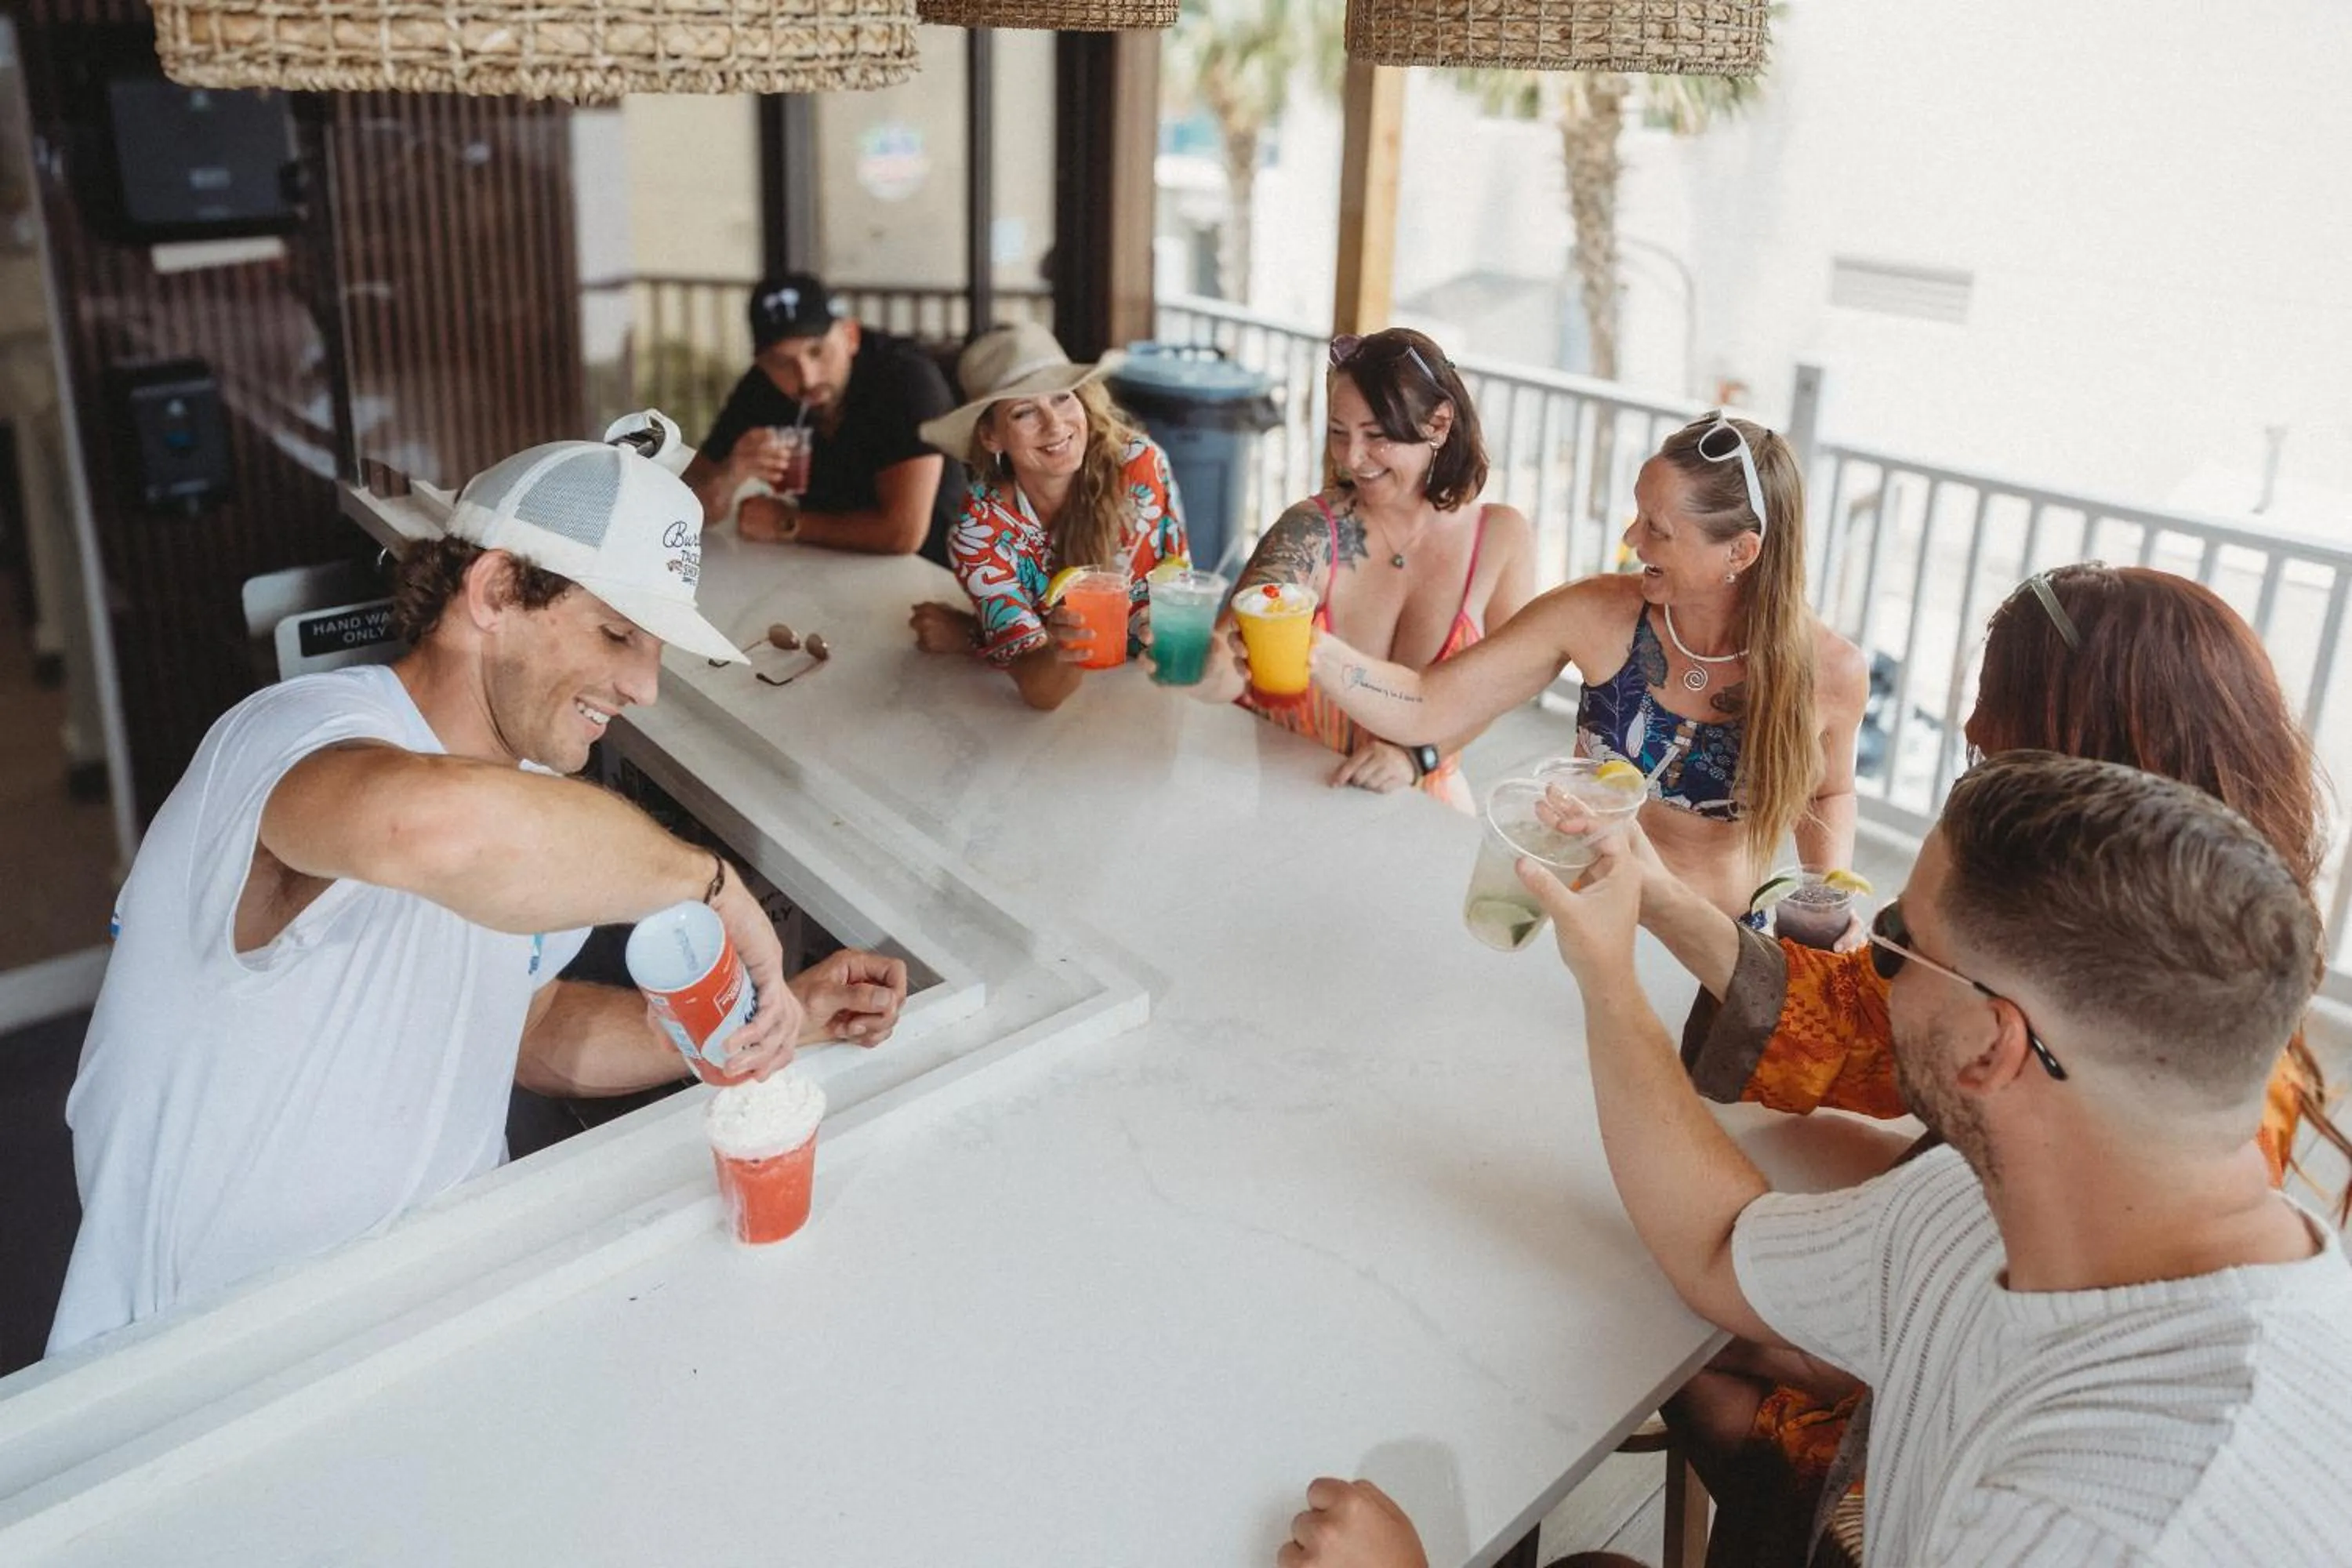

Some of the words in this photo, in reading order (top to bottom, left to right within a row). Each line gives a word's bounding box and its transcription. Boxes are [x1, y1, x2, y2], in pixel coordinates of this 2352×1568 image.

[313, 616, 361, 636] HAND
[365, 611, 390, 626] WA
[343, 626, 387, 644] ONLY
